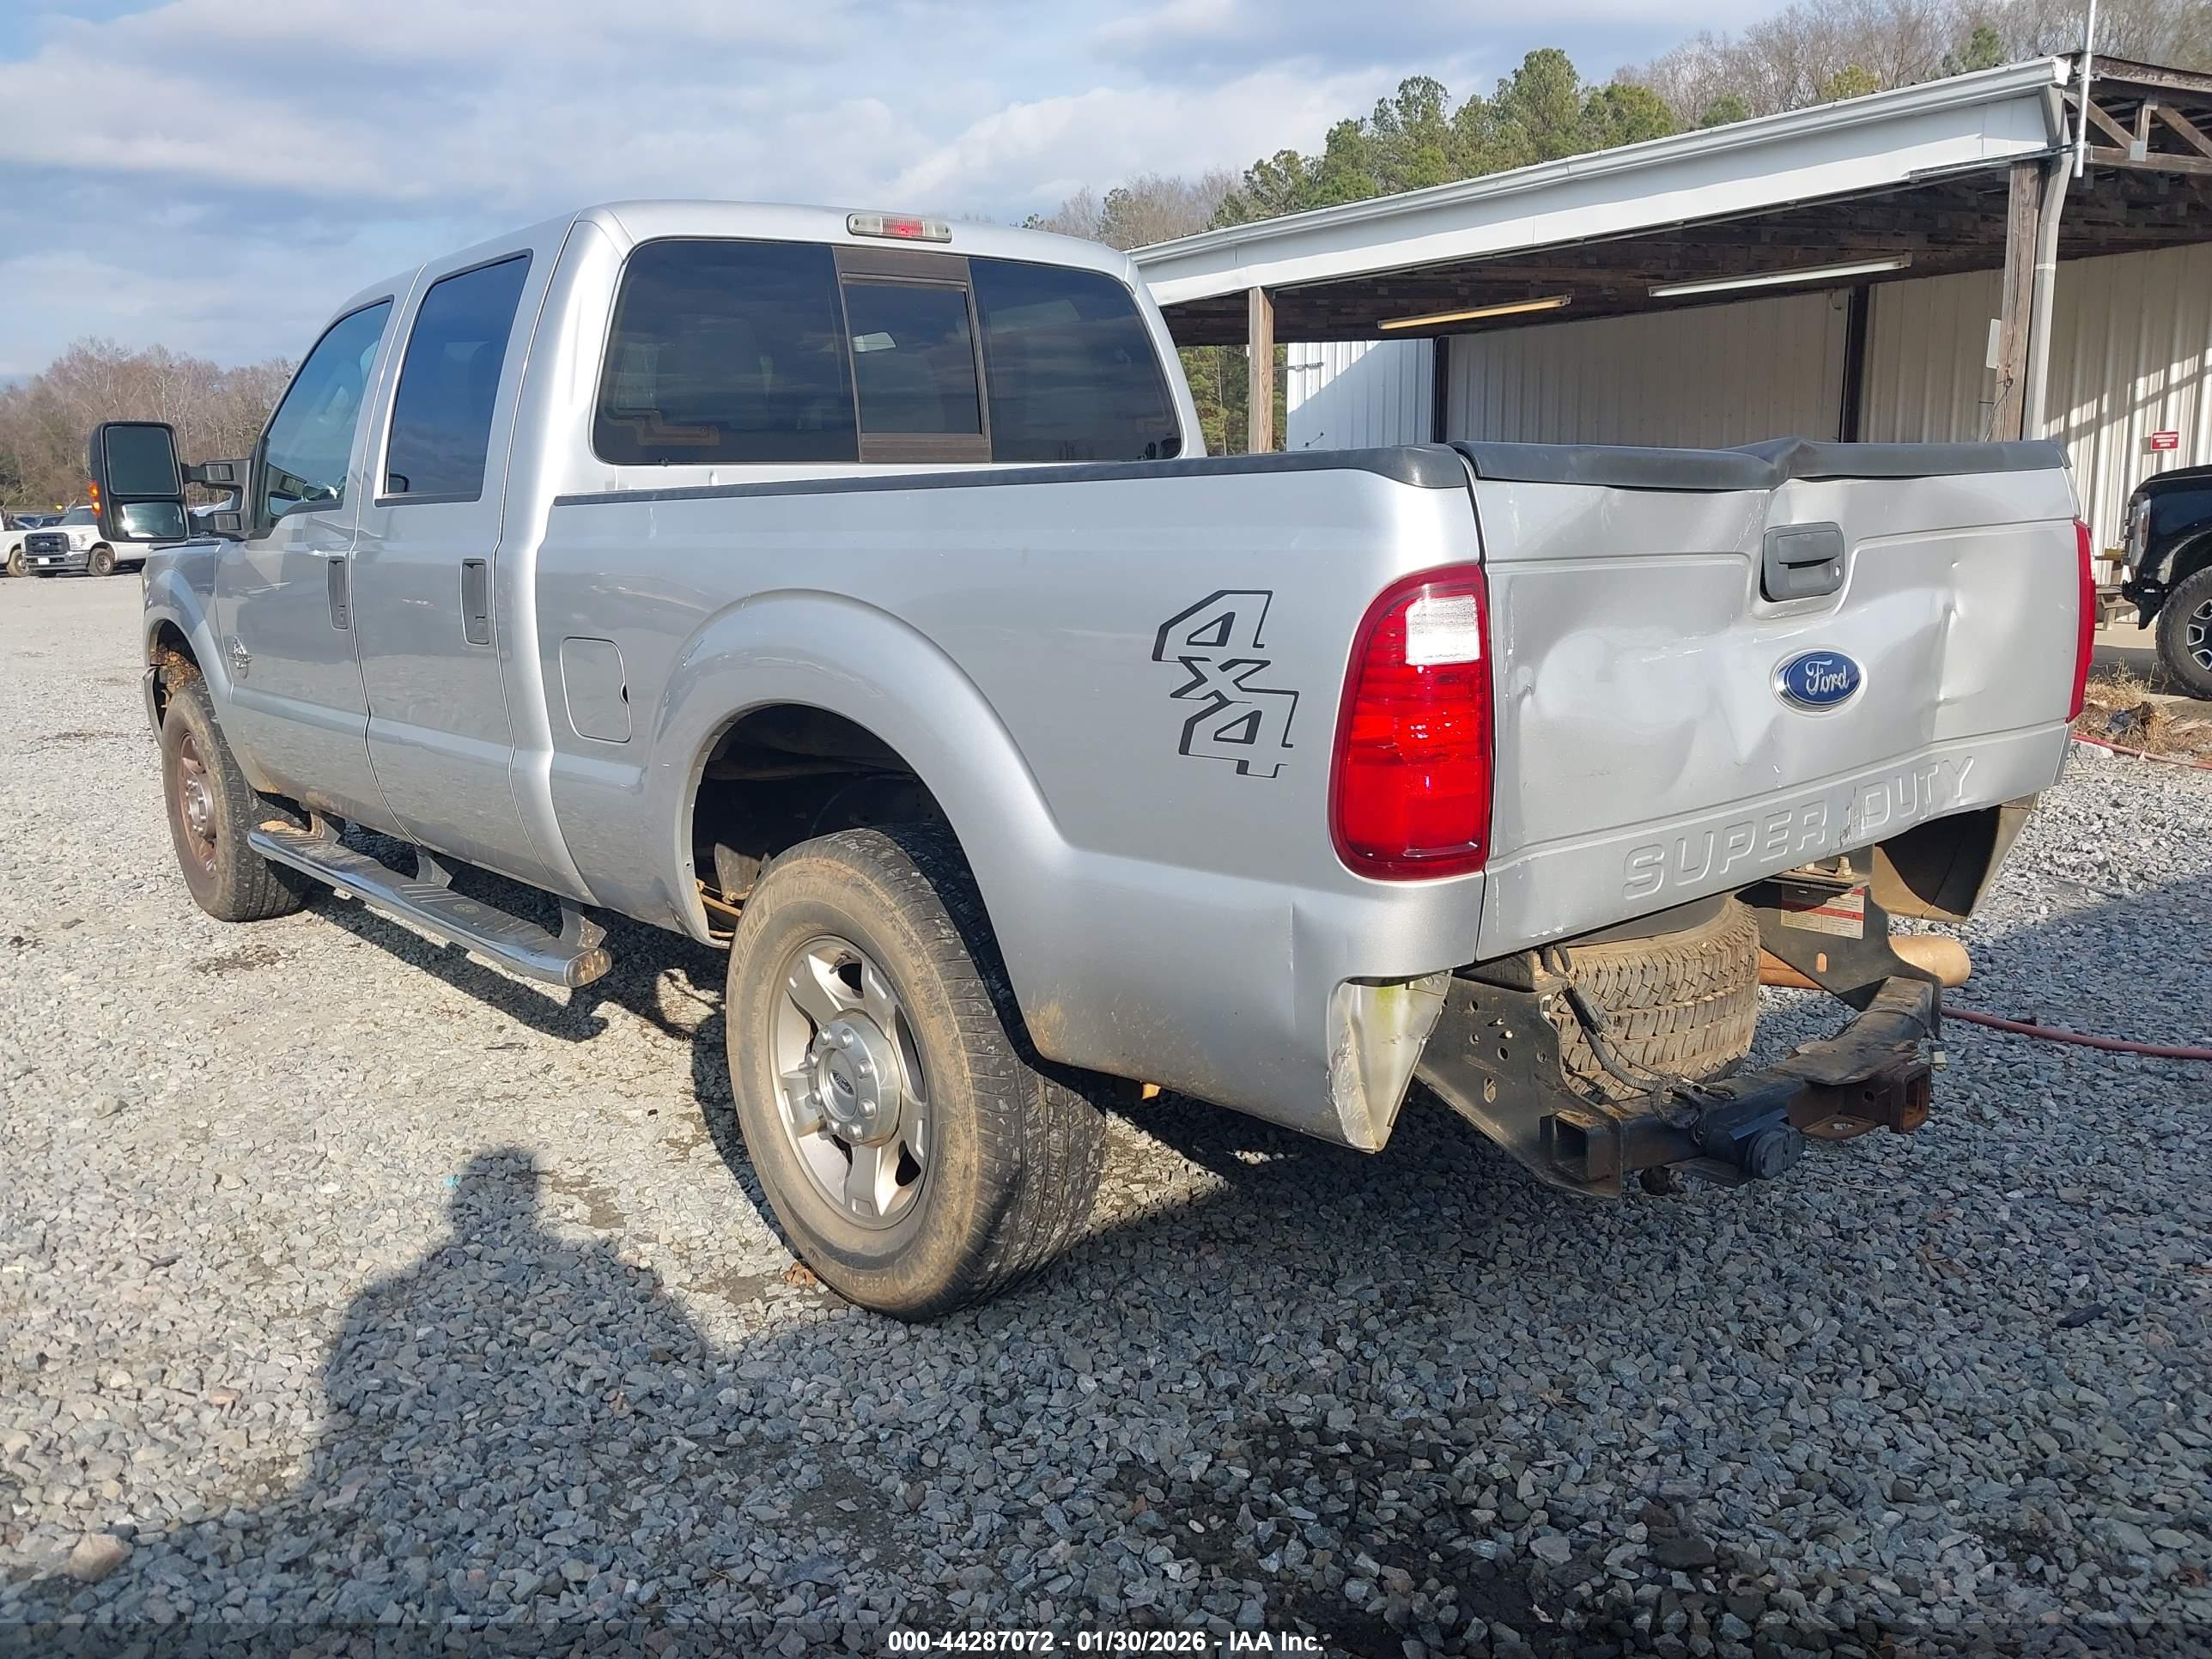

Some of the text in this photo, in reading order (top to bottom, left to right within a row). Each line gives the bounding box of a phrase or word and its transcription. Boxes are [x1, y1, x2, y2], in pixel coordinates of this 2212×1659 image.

[1804, 659, 1850, 695] Ford
[1621, 756, 1975, 901] SUPER DUTY
